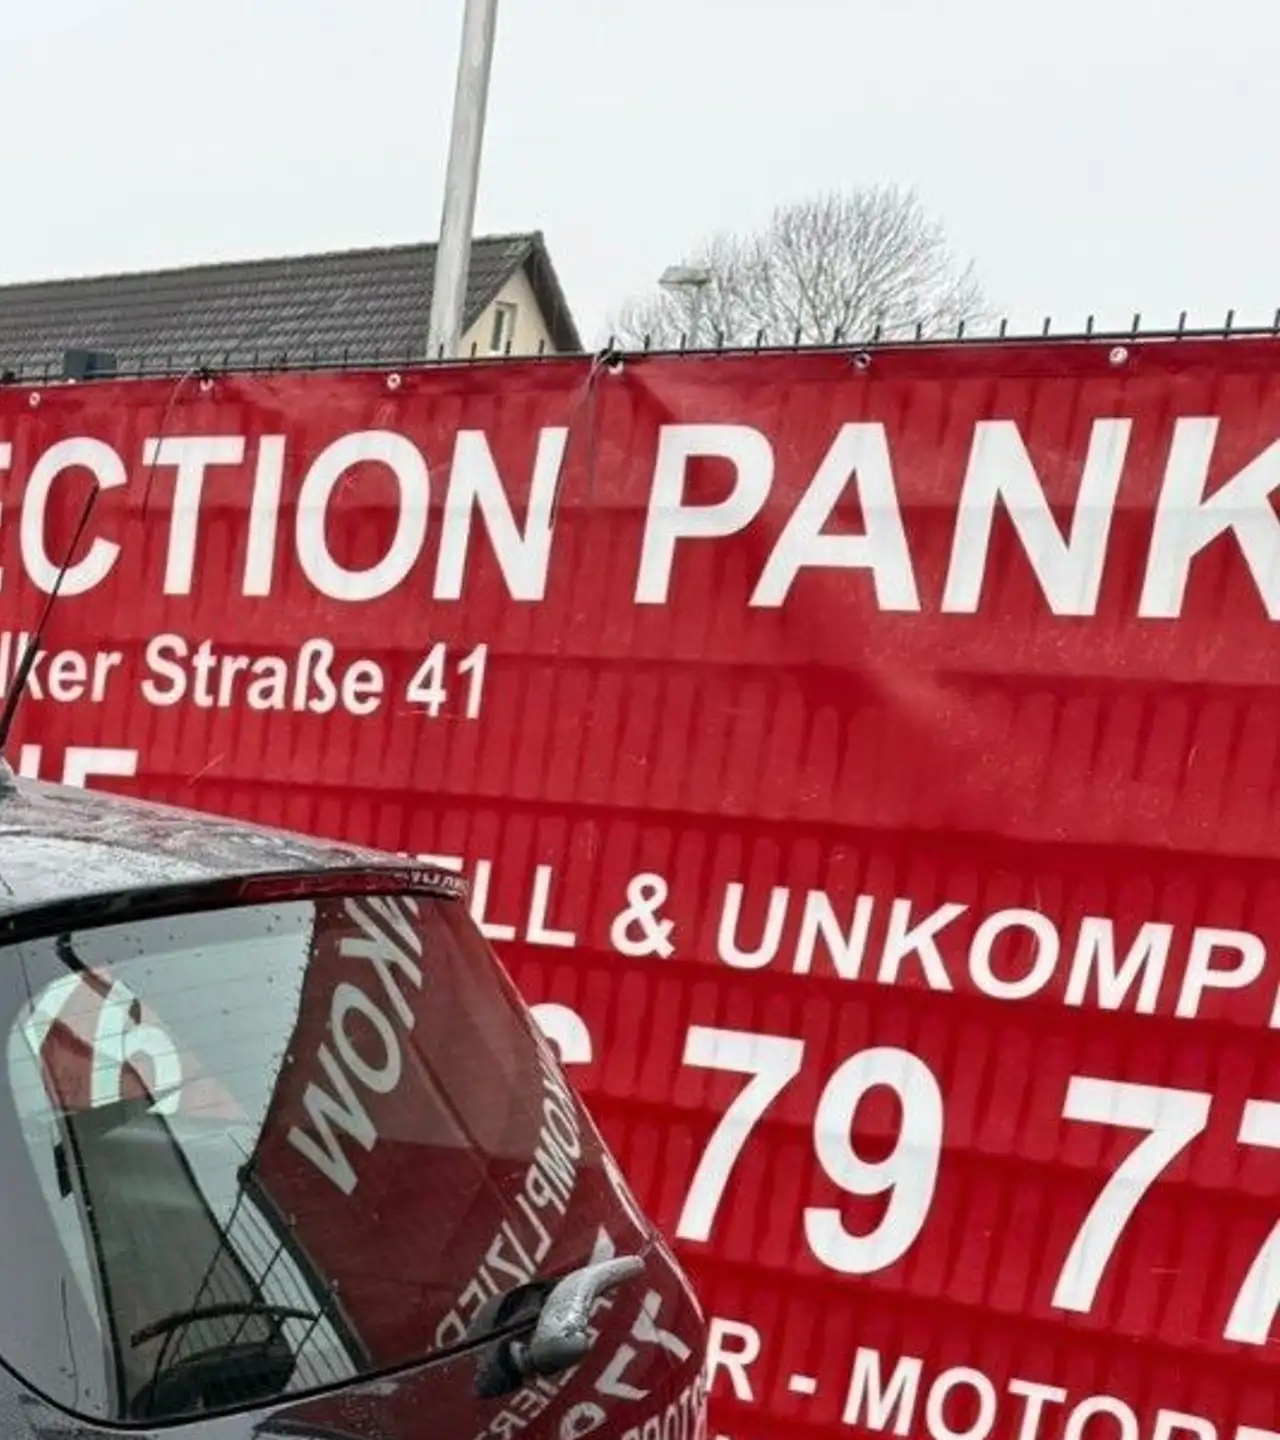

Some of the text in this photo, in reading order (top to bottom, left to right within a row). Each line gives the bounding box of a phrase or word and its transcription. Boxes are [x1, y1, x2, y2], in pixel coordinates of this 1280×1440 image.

[141, 634, 385, 717] Straße
[406, 642, 487, 719] 41
[610, 873, 675, 959] &
[717, 883, 1280, 1029] UNKOMP
